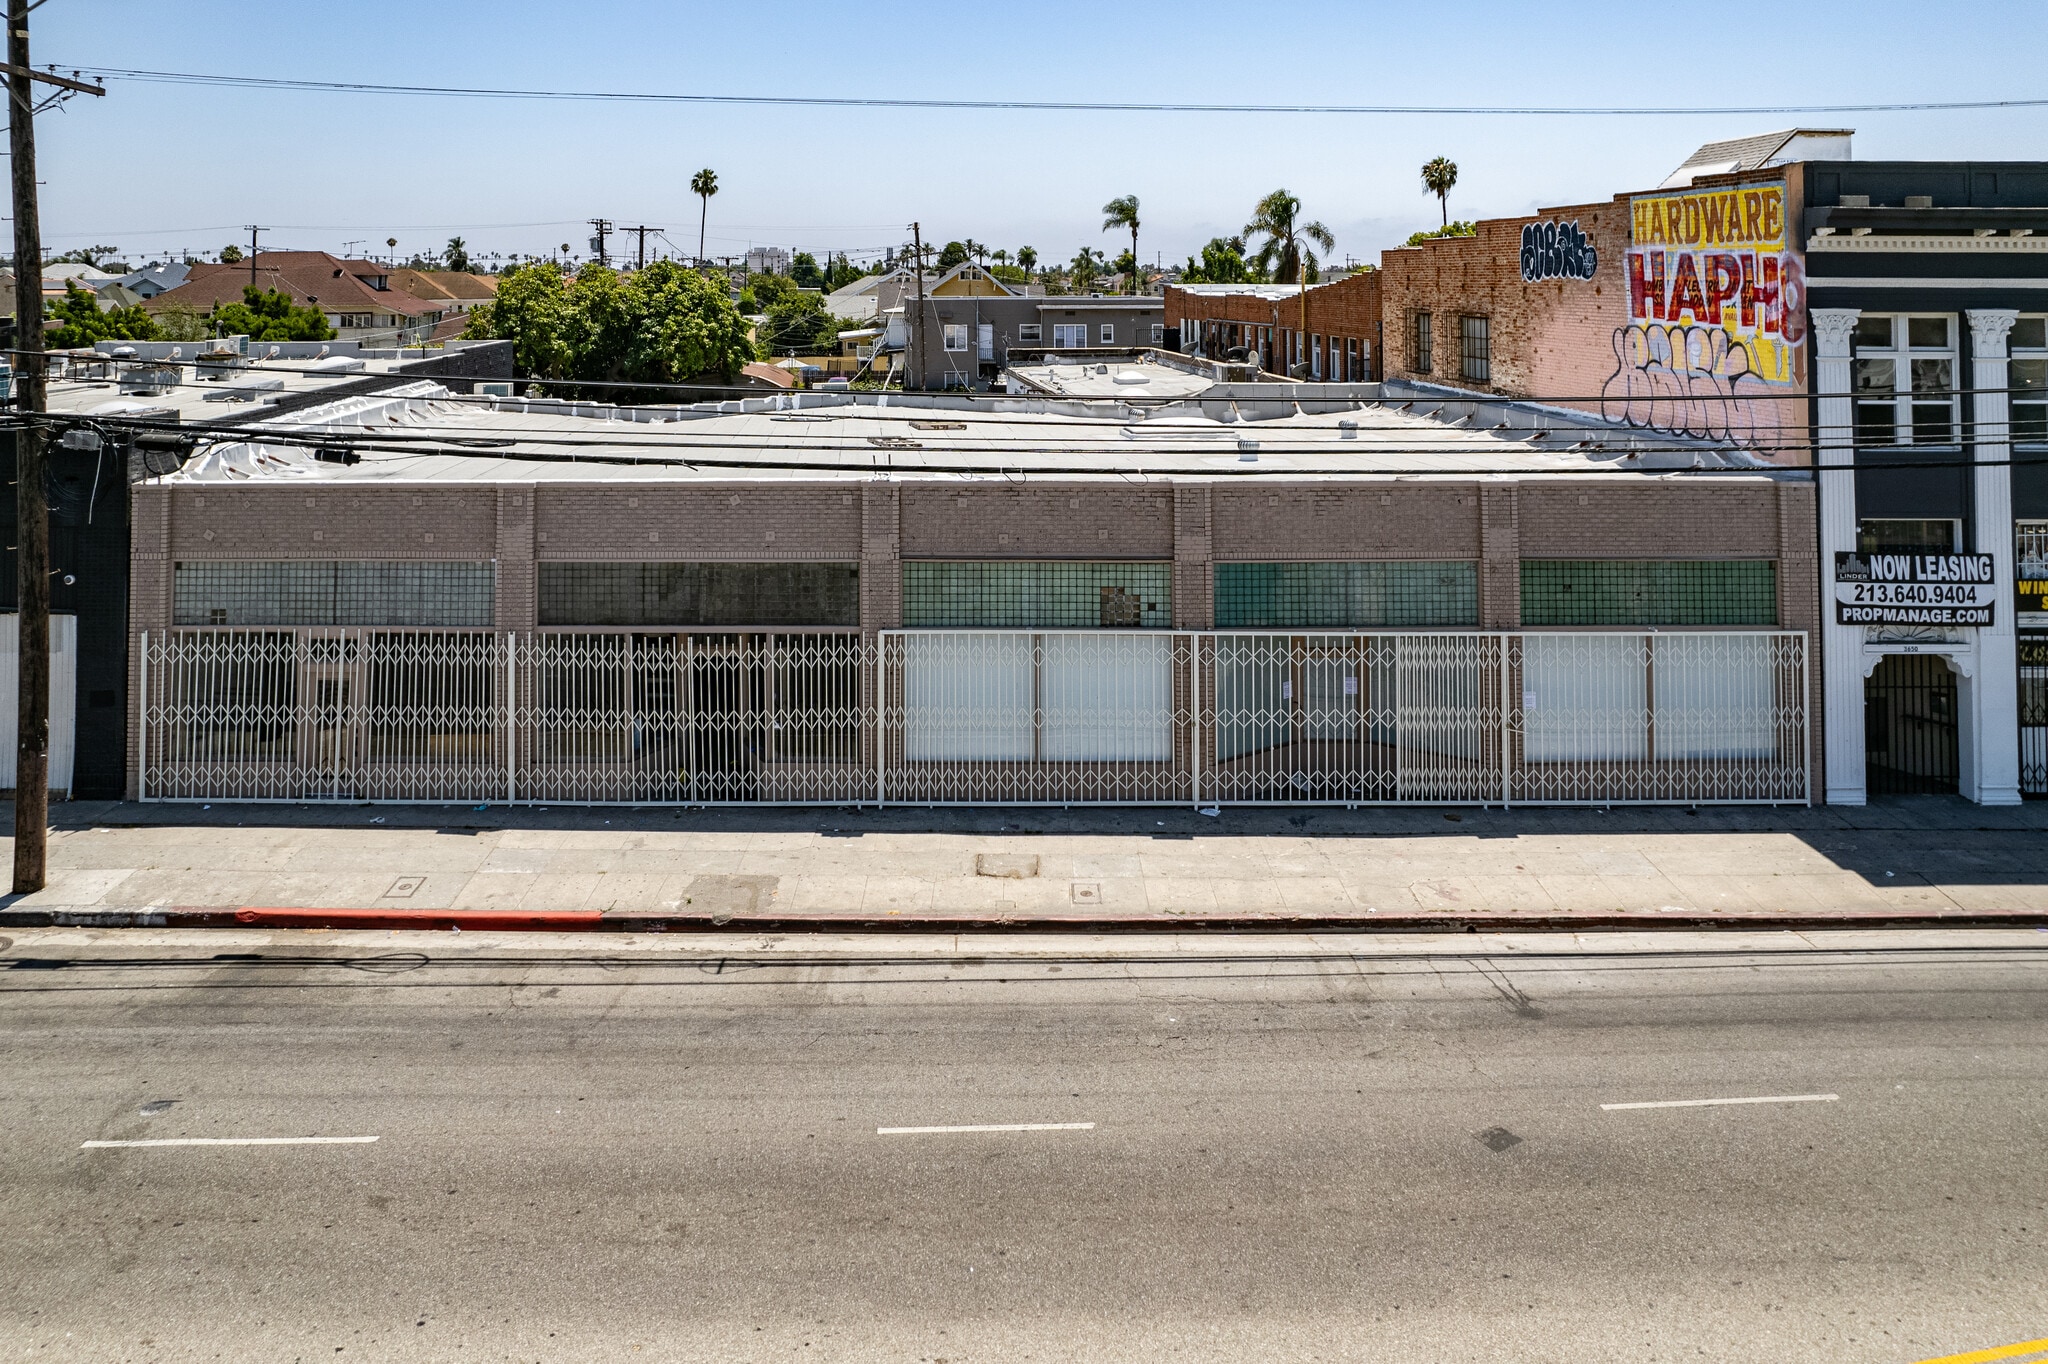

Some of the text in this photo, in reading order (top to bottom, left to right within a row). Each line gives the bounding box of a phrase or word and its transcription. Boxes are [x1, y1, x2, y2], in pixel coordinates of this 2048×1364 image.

[1633, 189, 1783, 246] HARDWARE
[1869, 555, 1991, 581] NOW LEASING
[1854, 584, 1977, 603] 213.640.9404
[1842, 608, 1989, 623] PROPMANAGE.COM
